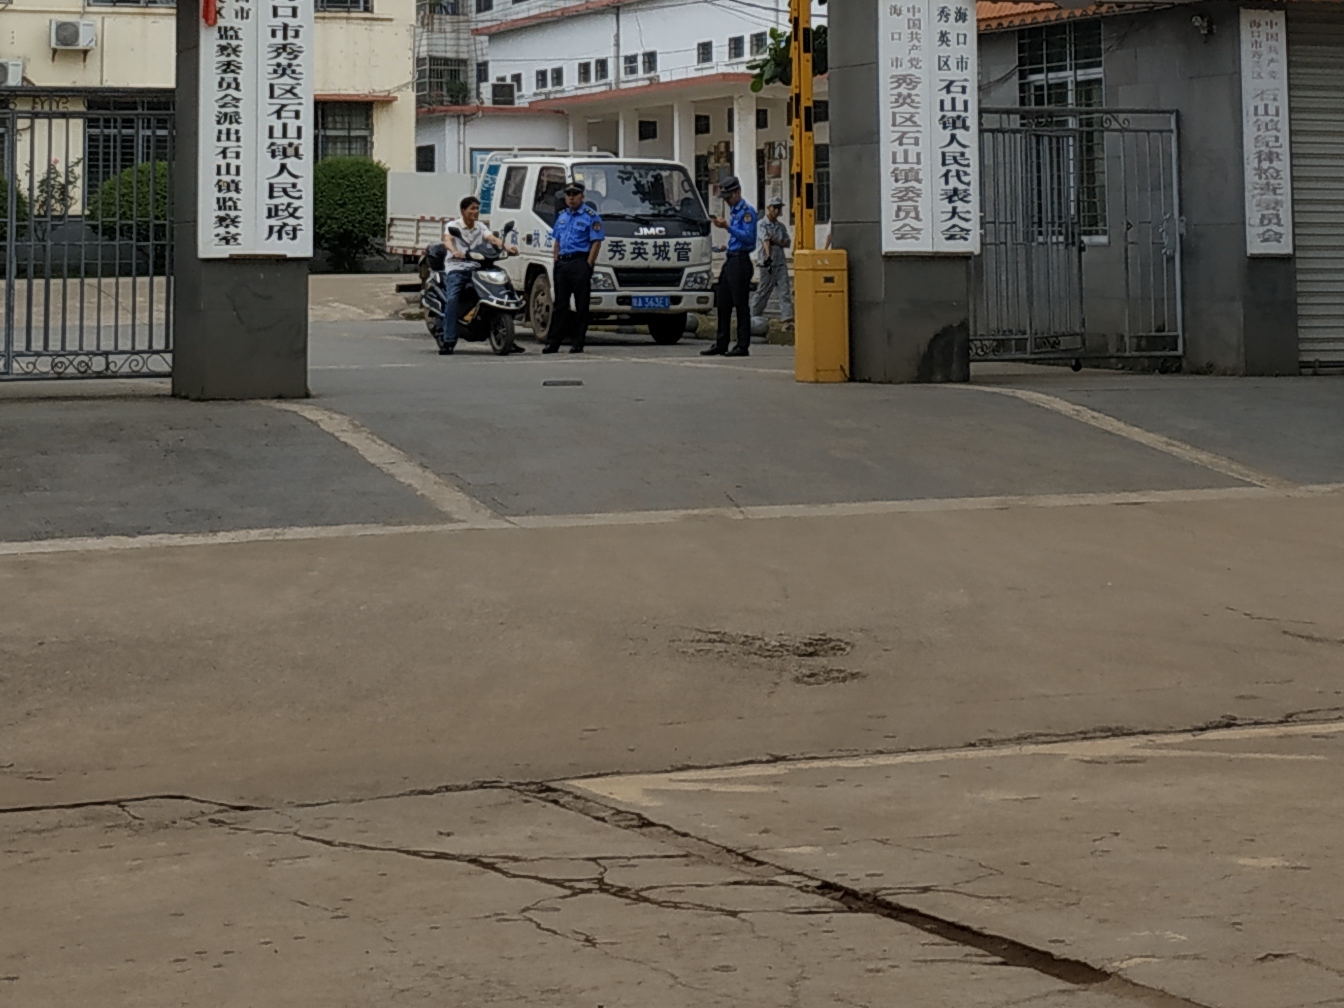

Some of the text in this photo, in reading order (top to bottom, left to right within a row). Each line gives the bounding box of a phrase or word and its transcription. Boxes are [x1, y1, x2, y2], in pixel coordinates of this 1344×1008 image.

[889, 4, 904, 70] 海口市
[907, 4, 922, 70] 中国共产党
[936, 6, 951, 72] 秀英区
[954, 6, 970, 72] 海口市
[213, 25, 244, 247] 监察委员会派出石山镇监察室
[889, 73, 923, 242] 秀英区石山镇委员会
[937, 78, 972, 242] 石山镇人民代表大会
[607, 240, 692, 263] 秀英城管
[633, 226, 666, 236] JMC
